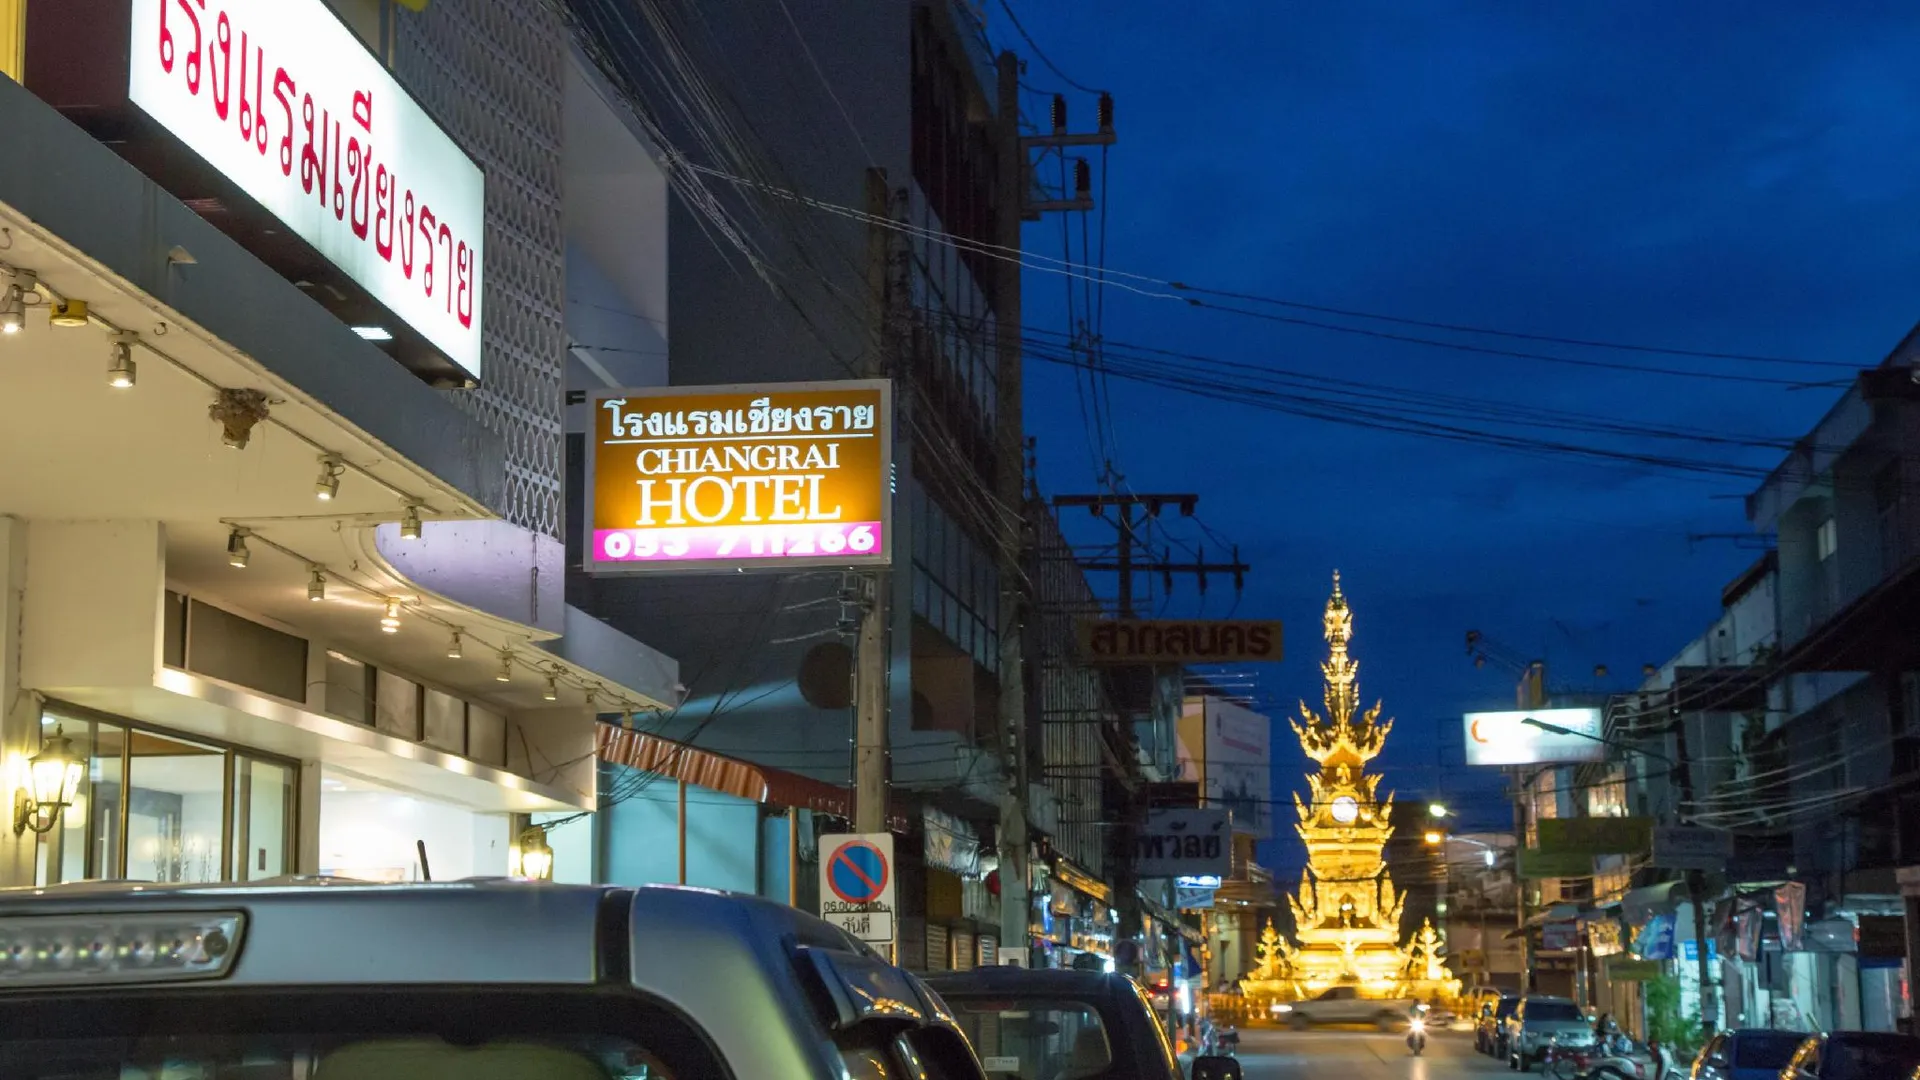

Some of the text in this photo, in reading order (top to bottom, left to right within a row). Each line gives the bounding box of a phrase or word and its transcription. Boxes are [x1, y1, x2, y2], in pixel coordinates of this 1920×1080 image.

[603, 397, 875, 437] โรงแรมเชียงราย
[636, 443, 840, 476] CHIANGRAI
[635, 473, 841, 526] HOTEL
[603, 525, 875, 559] 053 711266
